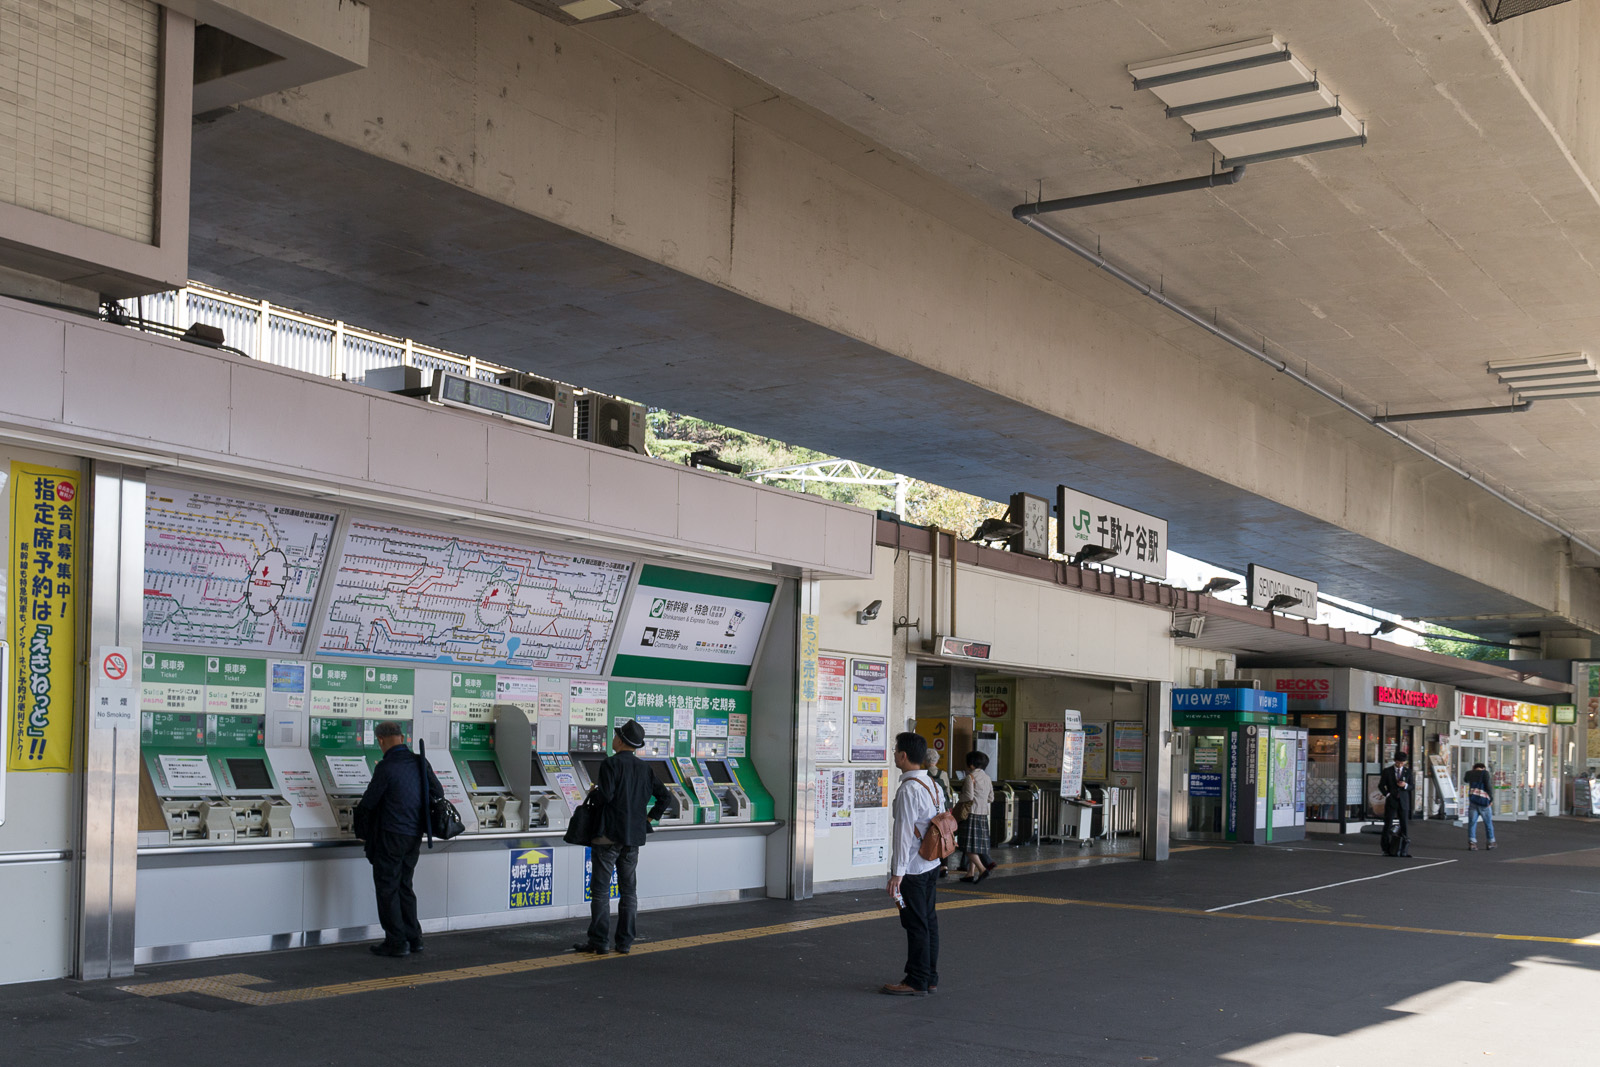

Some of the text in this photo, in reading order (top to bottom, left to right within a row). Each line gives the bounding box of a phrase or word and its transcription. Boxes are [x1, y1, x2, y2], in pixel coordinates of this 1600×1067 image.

[1073, 509, 1091, 534] JR
[56, 504, 73, 618] 会員募集中！
[662, 613, 685, 622] Shinkansen
[691, 616, 706, 625] Express
[657, 628, 681, 641] 定期券
[654, 640, 676, 650] Commuter
[160, 660, 185, 671] 乗車券
[224, 663, 247, 674] 乗車券
[1276, 679, 1330, 690] BECK'S
[1423, 692, 1439, 709] SHOP
[510, 890, 552, 907] ご購入できます
